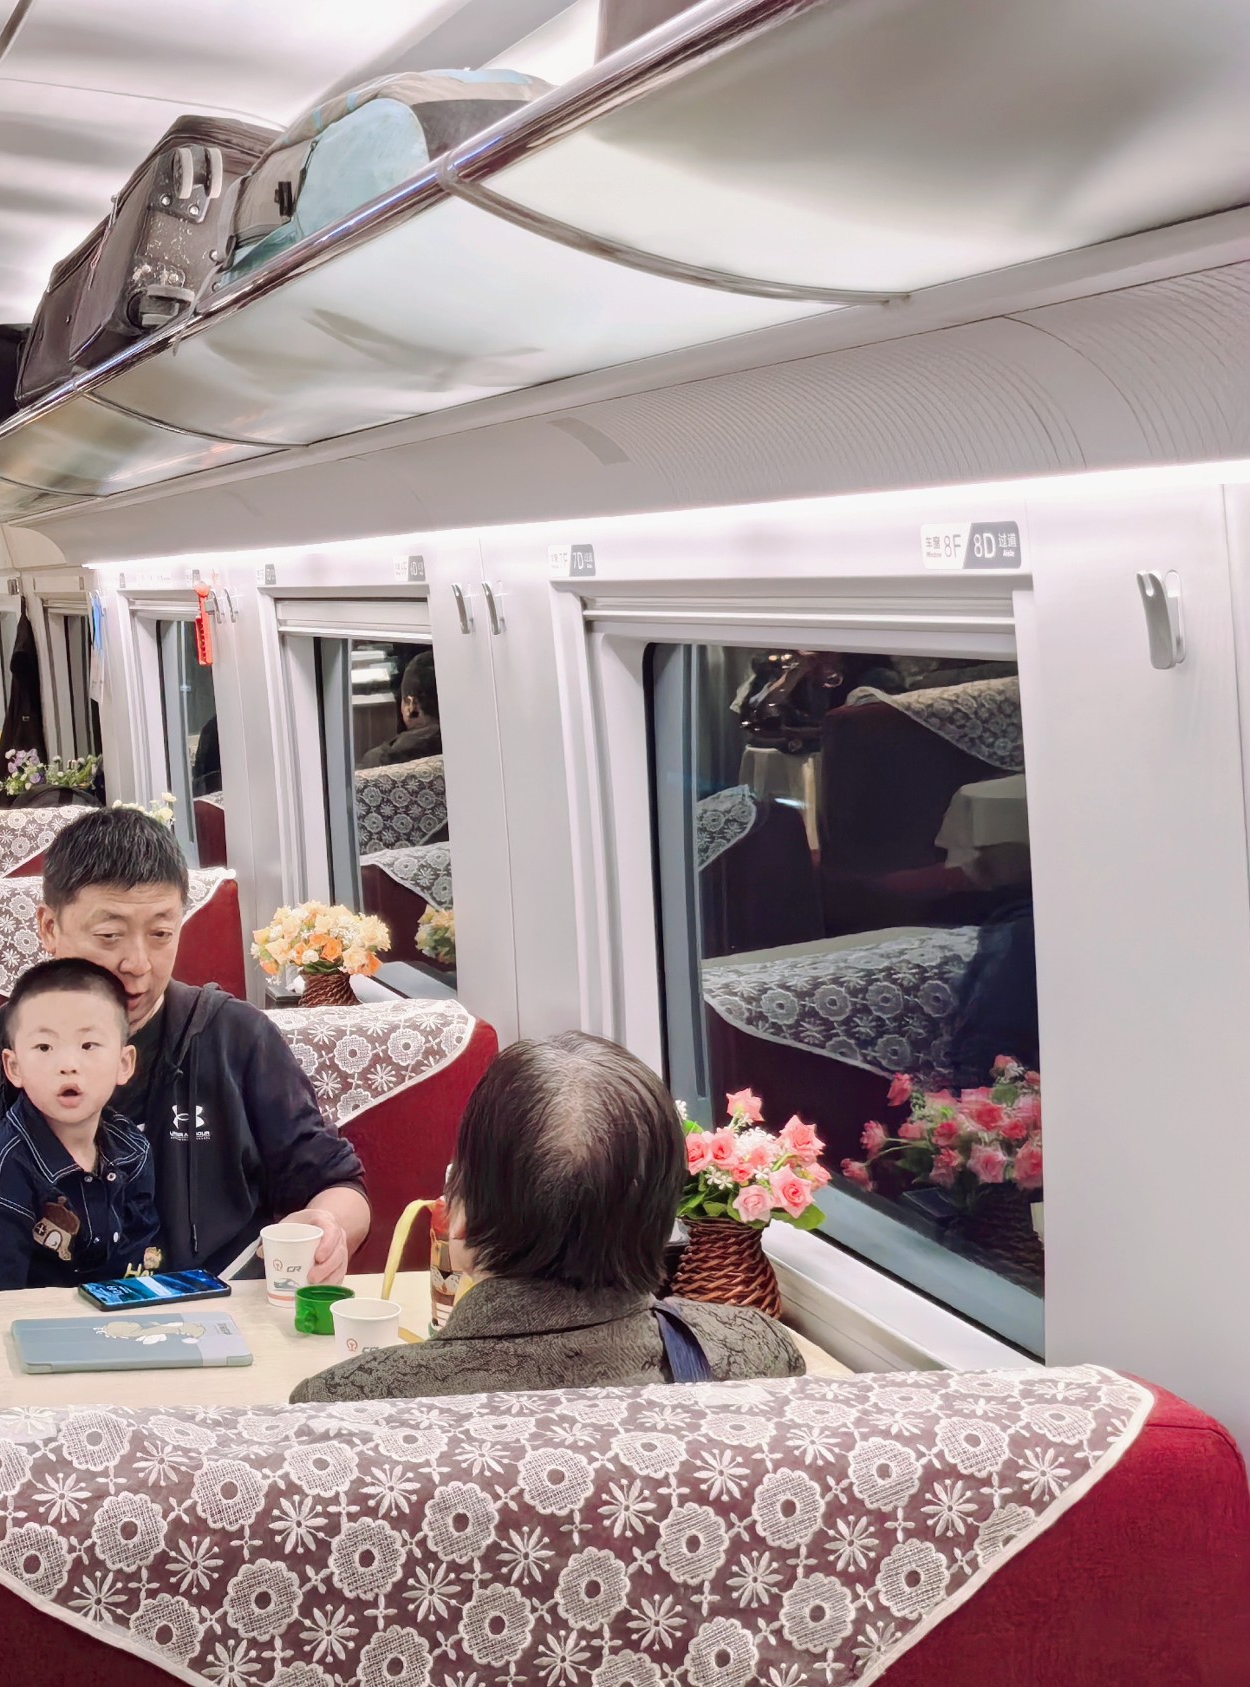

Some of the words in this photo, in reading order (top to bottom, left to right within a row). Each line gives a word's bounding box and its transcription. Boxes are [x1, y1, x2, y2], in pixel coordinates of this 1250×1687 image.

[944, 534, 961, 559] 8F
[973, 532, 996, 558] 8D
[286, 1265, 302, 1273] CR
